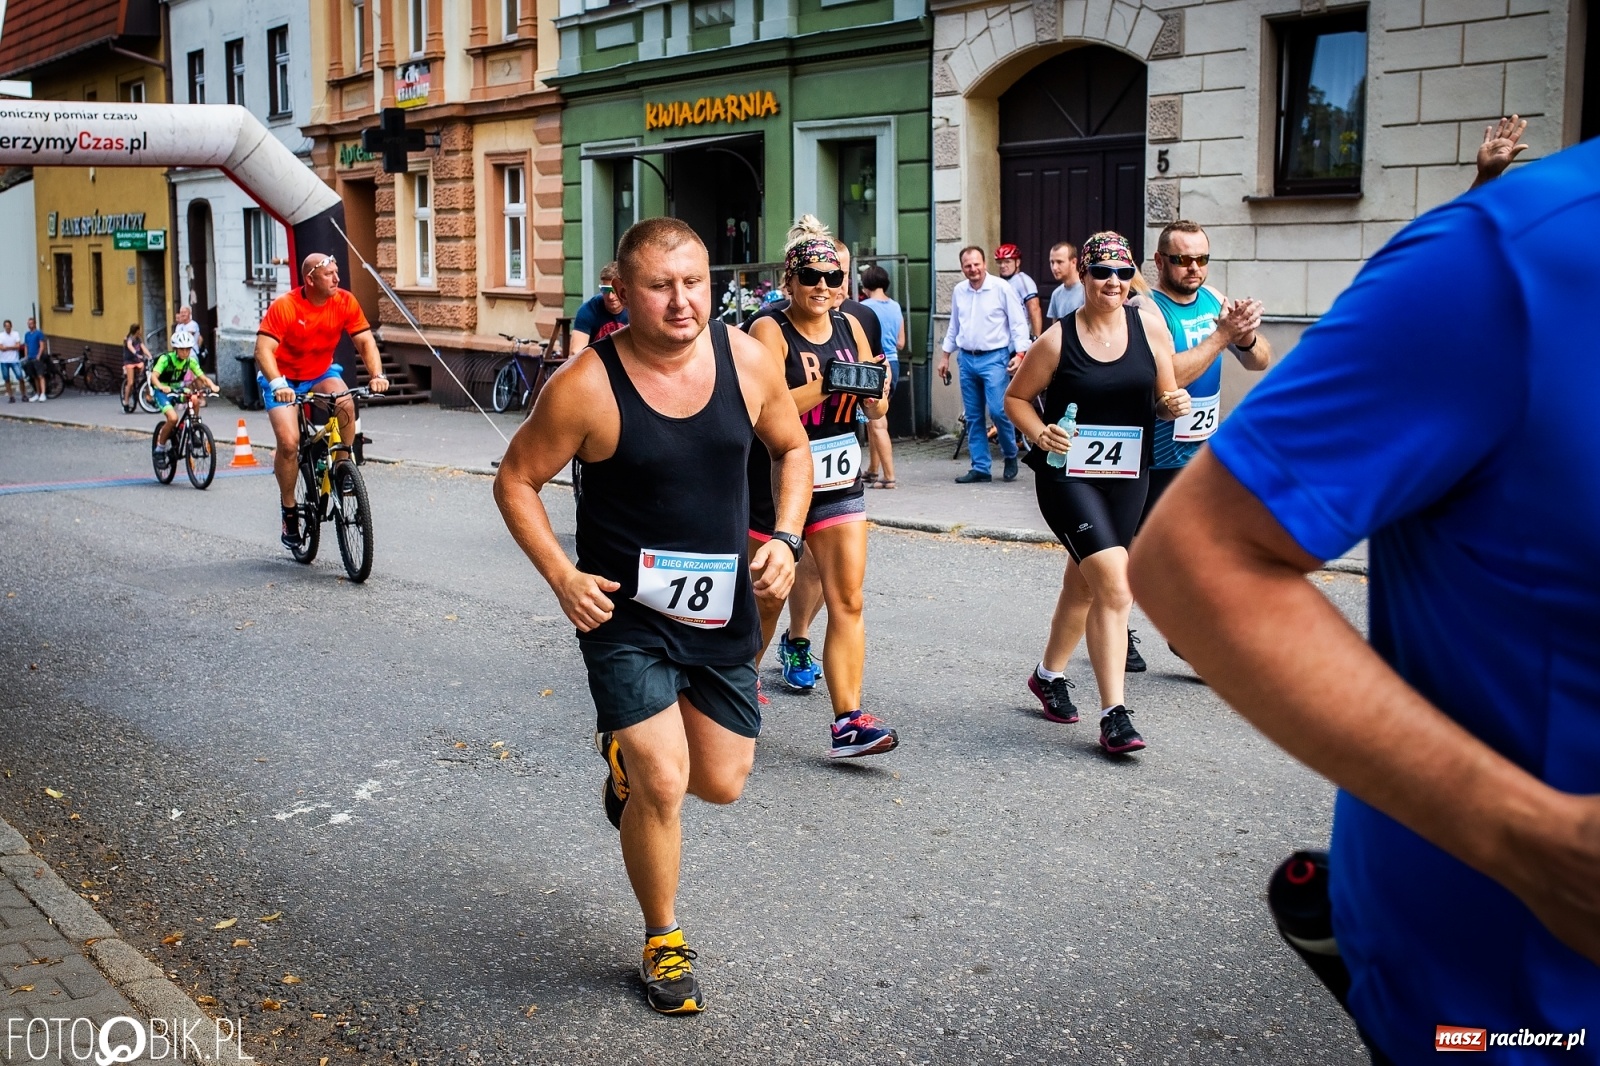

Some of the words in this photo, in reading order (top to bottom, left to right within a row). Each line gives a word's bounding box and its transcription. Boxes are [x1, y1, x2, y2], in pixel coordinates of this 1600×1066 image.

[54, 110, 99, 121] pomiar
[103, 112, 138, 121] czasu
[646, 90, 778, 130] KWIACIARNIA
[0, 131, 147, 154] erzymyCzas.pl
[1157, 148, 1170, 173] 5
[61, 217, 81, 238] BANK
[1190, 407, 1215, 431] 25
[814, 443, 826, 452] BIEG
[1085, 440, 1123, 466] 24
[821, 449, 851, 479] 16
[656, 559, 660, 567] I
[662, 559, 682, 568] BIEG
[683, 561, 733, 570] KRZANOWICKI
[667, 575, 714, 612] 18
